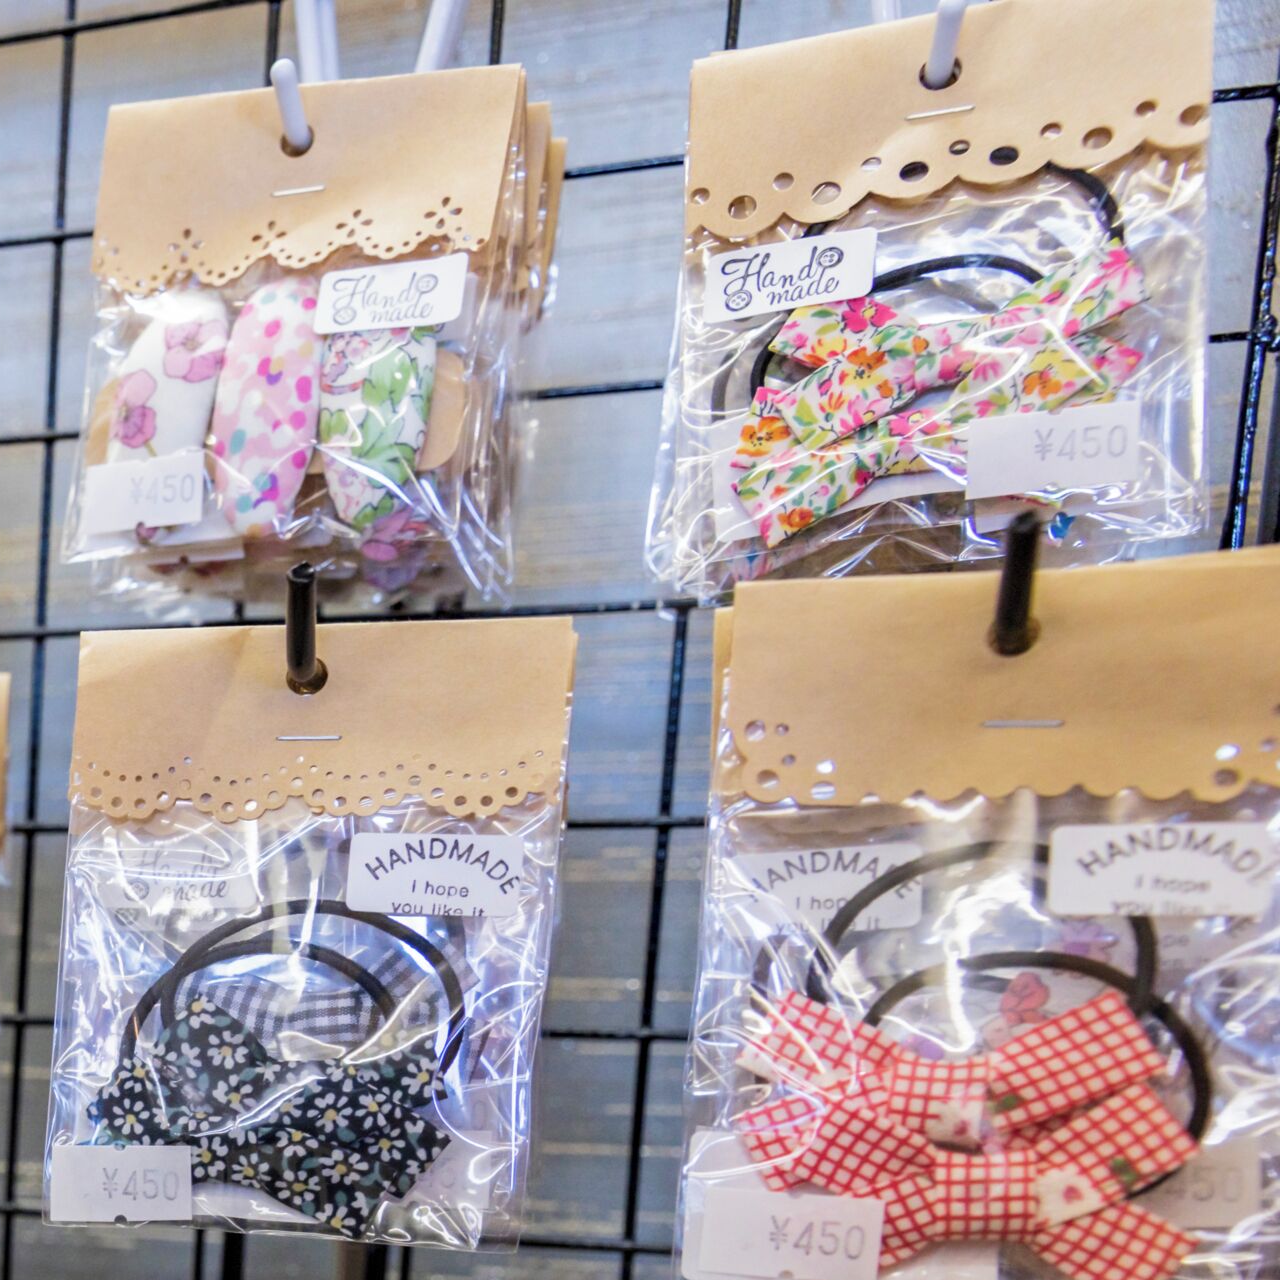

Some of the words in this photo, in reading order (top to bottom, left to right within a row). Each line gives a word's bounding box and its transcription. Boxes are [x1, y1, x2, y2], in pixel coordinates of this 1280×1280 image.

[721, 246, 818, 292] Hand
[766, 268, 840, 306] made
[332, 271, 418, 309] Hand
[369, 294, 434, 323] made
[1034, 424, 1128, 462] ¥450
[130, 473, 196, 505] ¥450
[364, 837, 521, 895] HANDMADE
[411, 879, 417, 893] I
[424, 880, 470, 899] hope
[810, 895, 848, 914] hop
[101, 1167, 181, 1202] ¥450
[769, 1214, 867, 1260] ¥450
